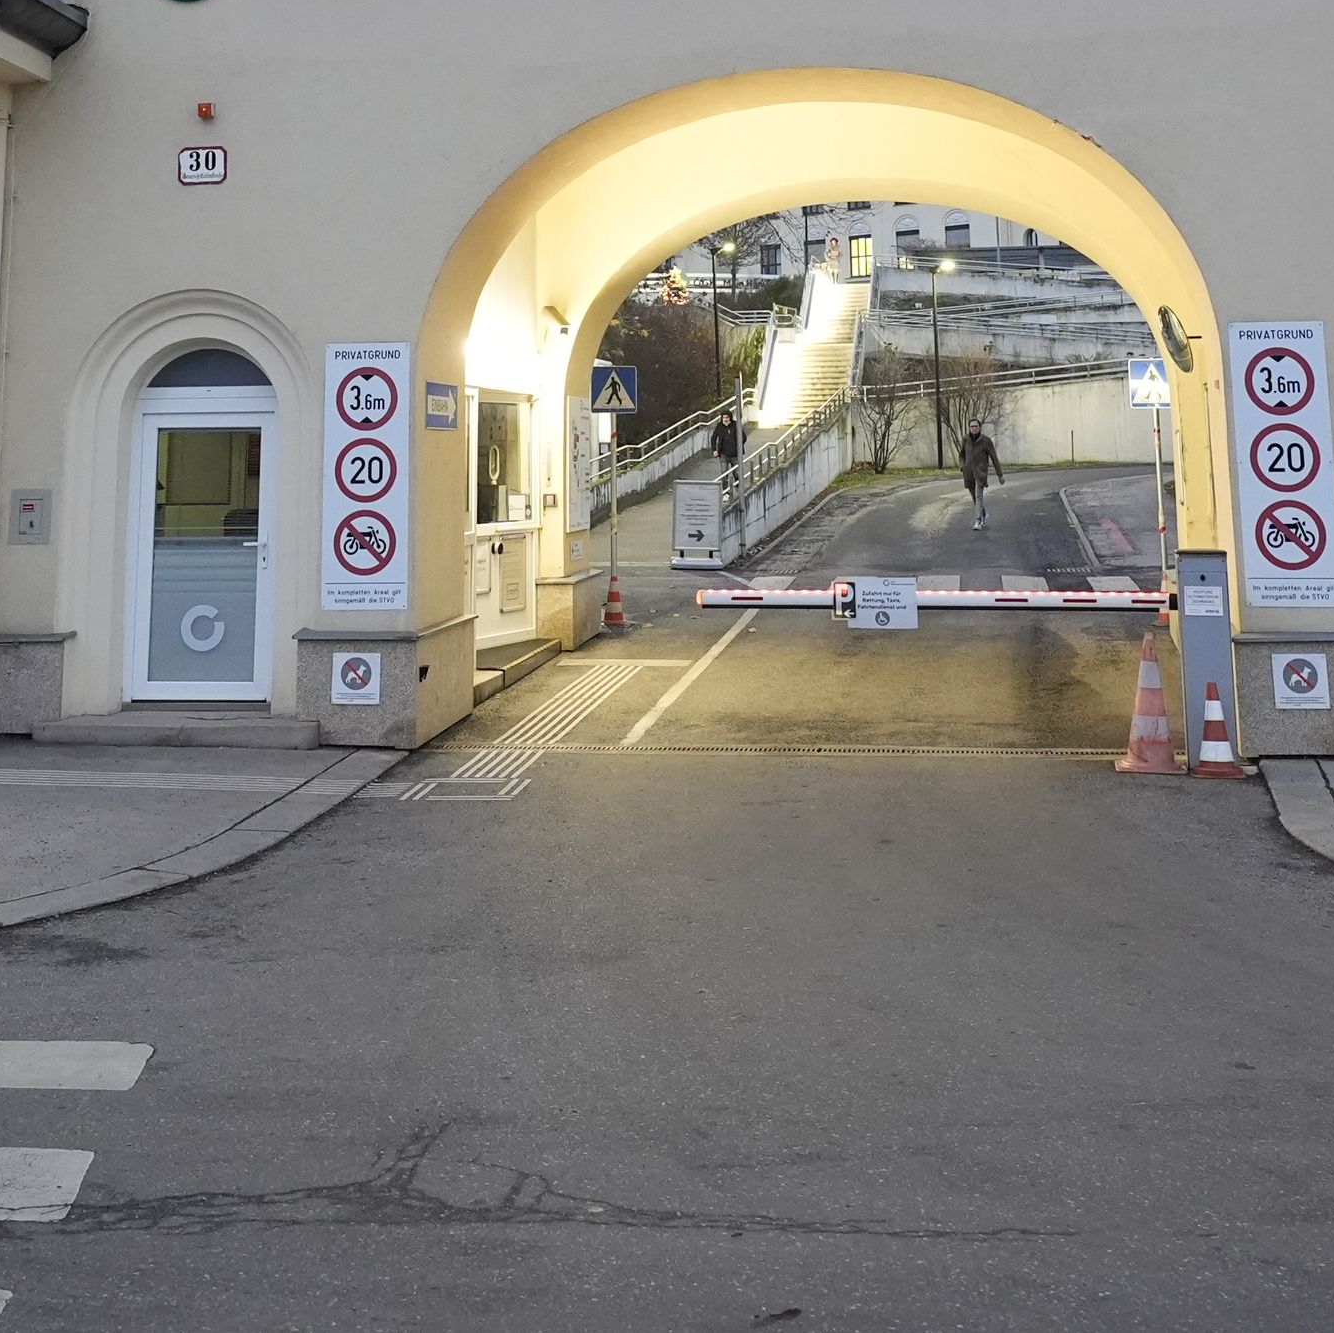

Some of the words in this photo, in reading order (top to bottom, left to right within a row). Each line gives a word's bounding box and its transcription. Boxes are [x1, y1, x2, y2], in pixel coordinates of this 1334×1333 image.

[189, 151, 216, 171] 30
[1239, 329, 1314, 340] PRIVATGRUND
[334, 349, 401, 360] PRIVATGRUND
[1259, 367, 1301, 394] 3.6m
[349, 385, 385, 410] 3.6m
[350, 456, 383, 484] 20
[1267, 443, 1305, 472] 20
[835, 583, 854, 615] P
